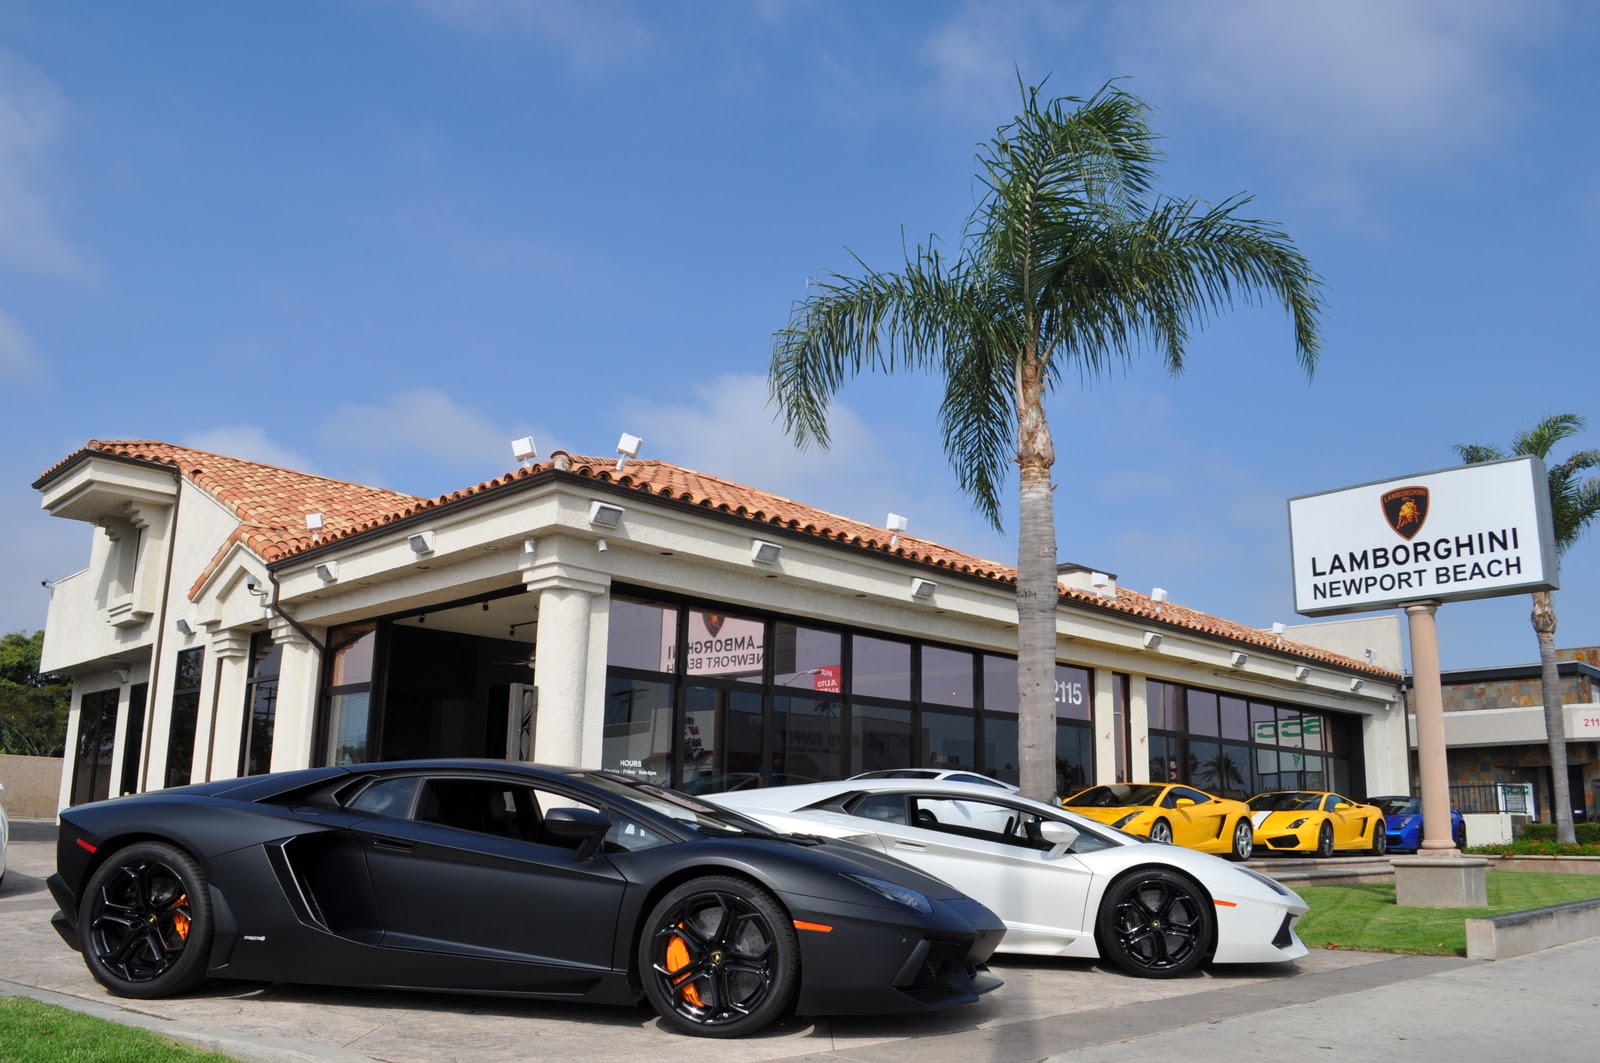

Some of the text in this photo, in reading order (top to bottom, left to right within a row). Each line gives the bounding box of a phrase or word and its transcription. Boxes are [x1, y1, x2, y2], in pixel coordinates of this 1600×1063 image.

[1384, 489, 1426, 503] LAMBORGHINI
[1311, 527, 1519, 577] LAMBORGHINI
[1313, 556, 1521, 600] NEWPORT BEACH
[622, 768, 636, 776] Friday
